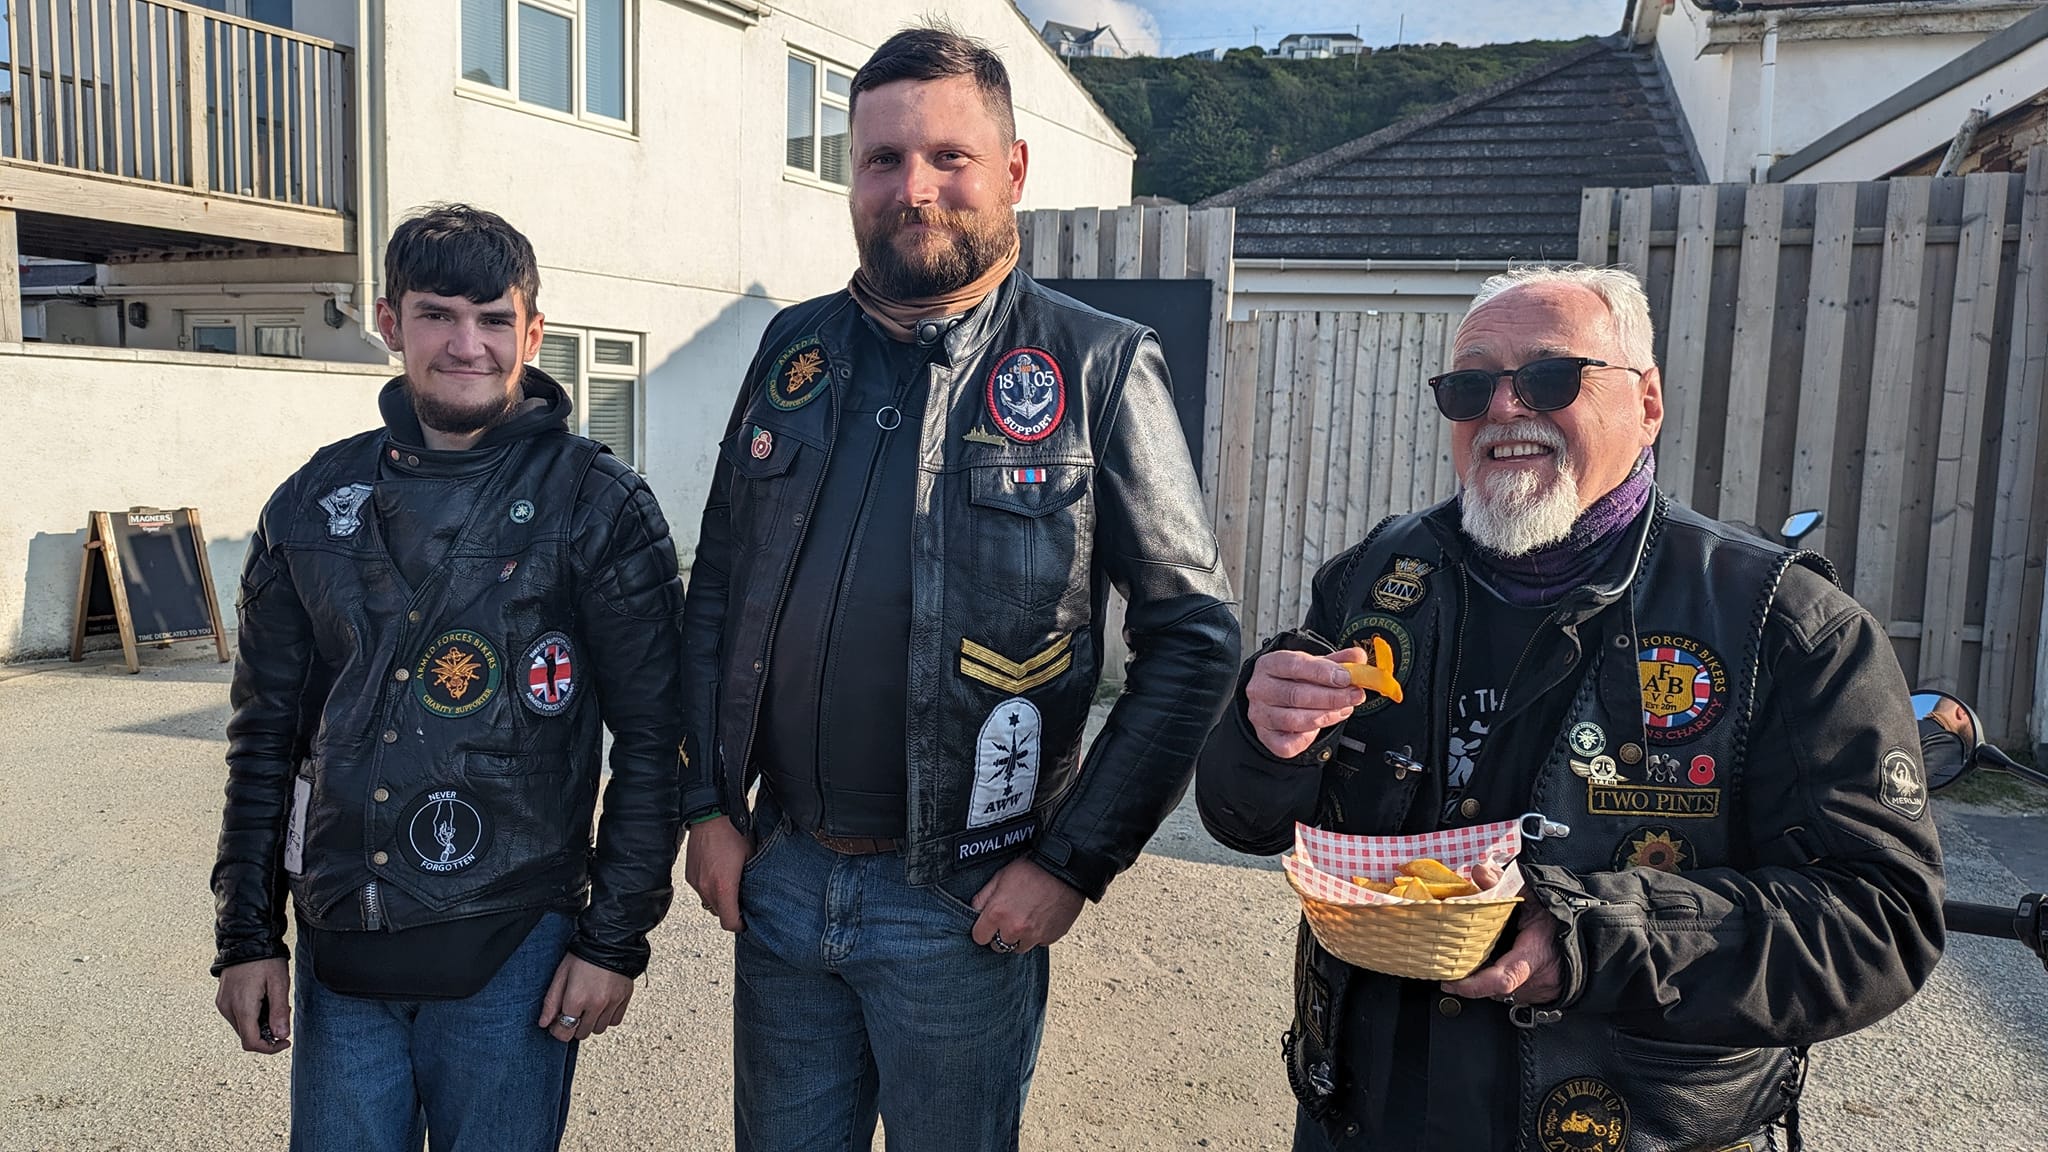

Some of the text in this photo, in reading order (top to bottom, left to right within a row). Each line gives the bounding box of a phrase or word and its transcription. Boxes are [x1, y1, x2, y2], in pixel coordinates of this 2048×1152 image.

[996, 371, 1055, 390] 18 05
[1003, 413, 1053, 436] SUPPORT
[130, 514, 171, 523] MAGNERS
[1382, 580, 1416, 598] MN
[154, 630, 188, 640] DEDICATED
[1363, 616, 1401, 634] FORCES
[1399, 633, 1411, 672] BIKERS
[416, 633, 497, 680] ARMED FORCES BIKERS
[1641, 635, 1726, 694] FORCES BIKERS
[422, 688, 494, 714] CHARITY SUPPORTER
[1661, 703, 1677, 711] 2011
[1666, 698, 1722, 739] CHARITY
[428, 790, 457, 801] NEVER
[983, 791, 1023, 814] AWW
[1594, 791, 1714, 813] TWO PINTS
[1891, 797, 1922, 805] MERLIN
[959, 824, 1035, 860] ROYAL NAVY
[420, 853, 476, 872] FORGOTTEN
[1552, 1081, 1621, 1111] IN MEMORY OF
